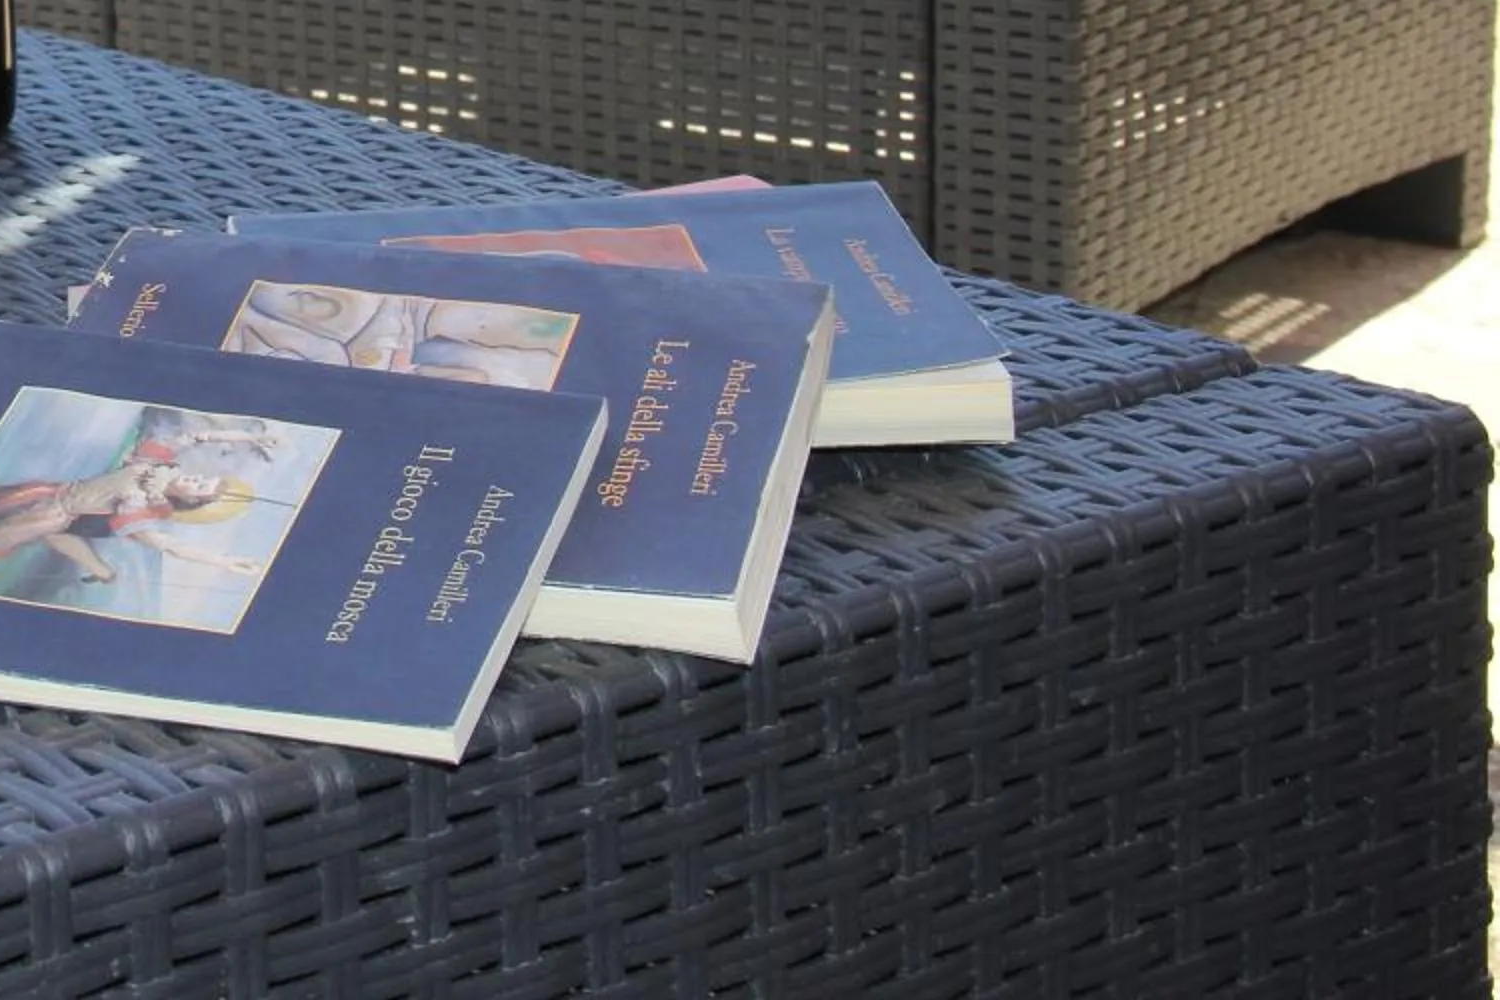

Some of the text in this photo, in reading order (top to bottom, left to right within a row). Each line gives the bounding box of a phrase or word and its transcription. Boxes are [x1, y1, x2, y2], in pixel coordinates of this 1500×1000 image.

[119, 283, 168, 338] Sellerio
[597, 340, 691, 508] Le ali della sfinge
[690, 358, 757, 497] Andrea Camilleri
[325, 444, 456, 643] Il gioco della mosca
[425, 484, 516, 623] Andrea Camilleri
